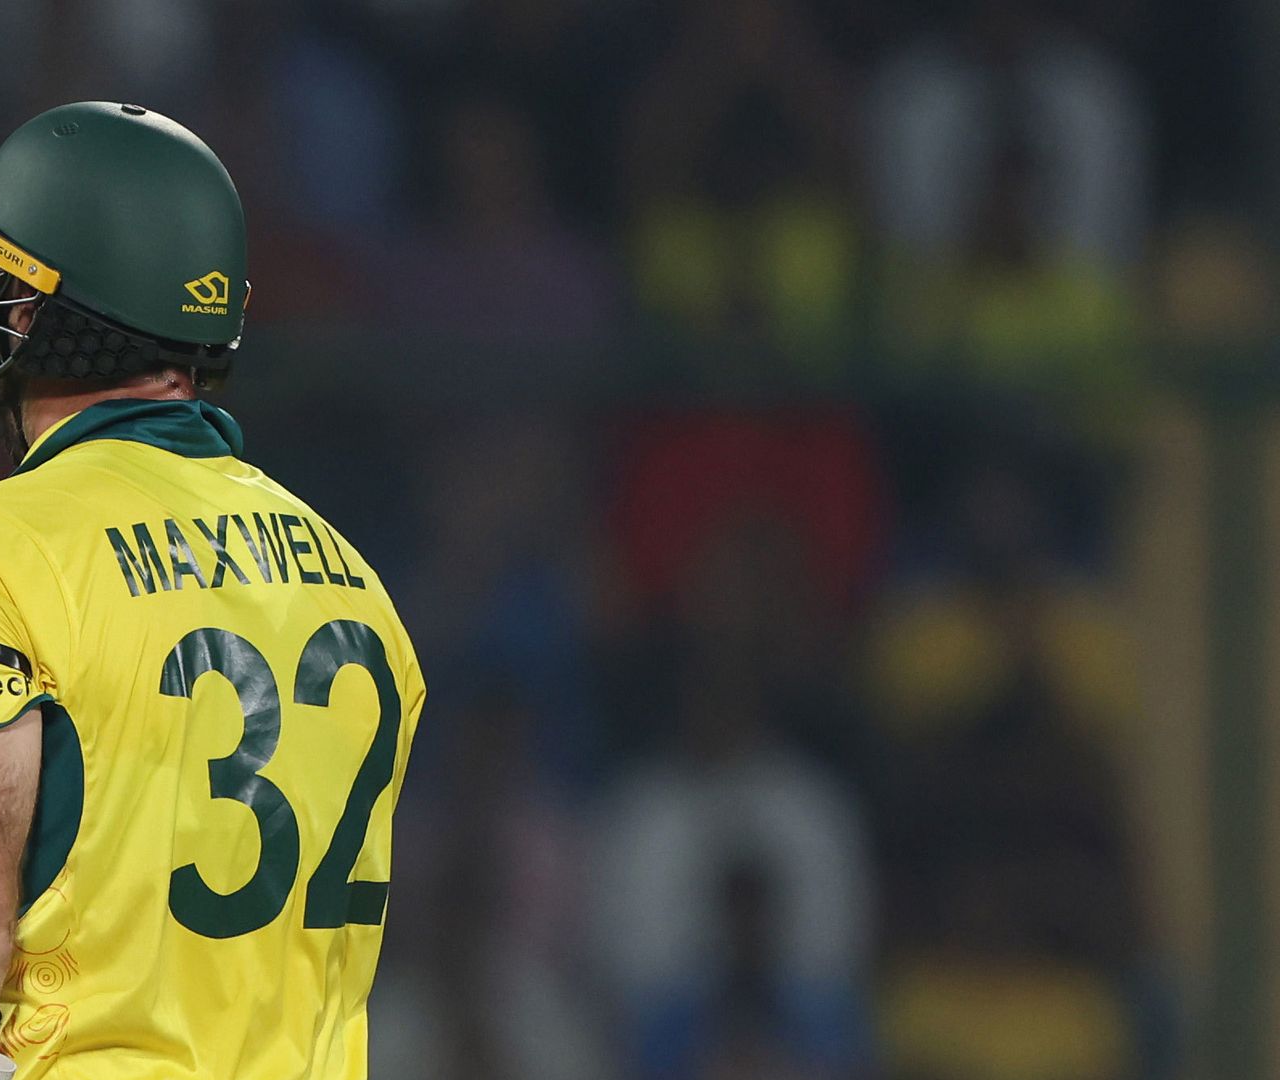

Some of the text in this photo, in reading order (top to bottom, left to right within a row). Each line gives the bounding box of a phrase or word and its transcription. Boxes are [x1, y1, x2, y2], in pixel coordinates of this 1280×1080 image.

[181, 304, 229, 316] MASURI
[105, 512, 366, 598] MAXWELL
[159, 619, 402, 939] 32
